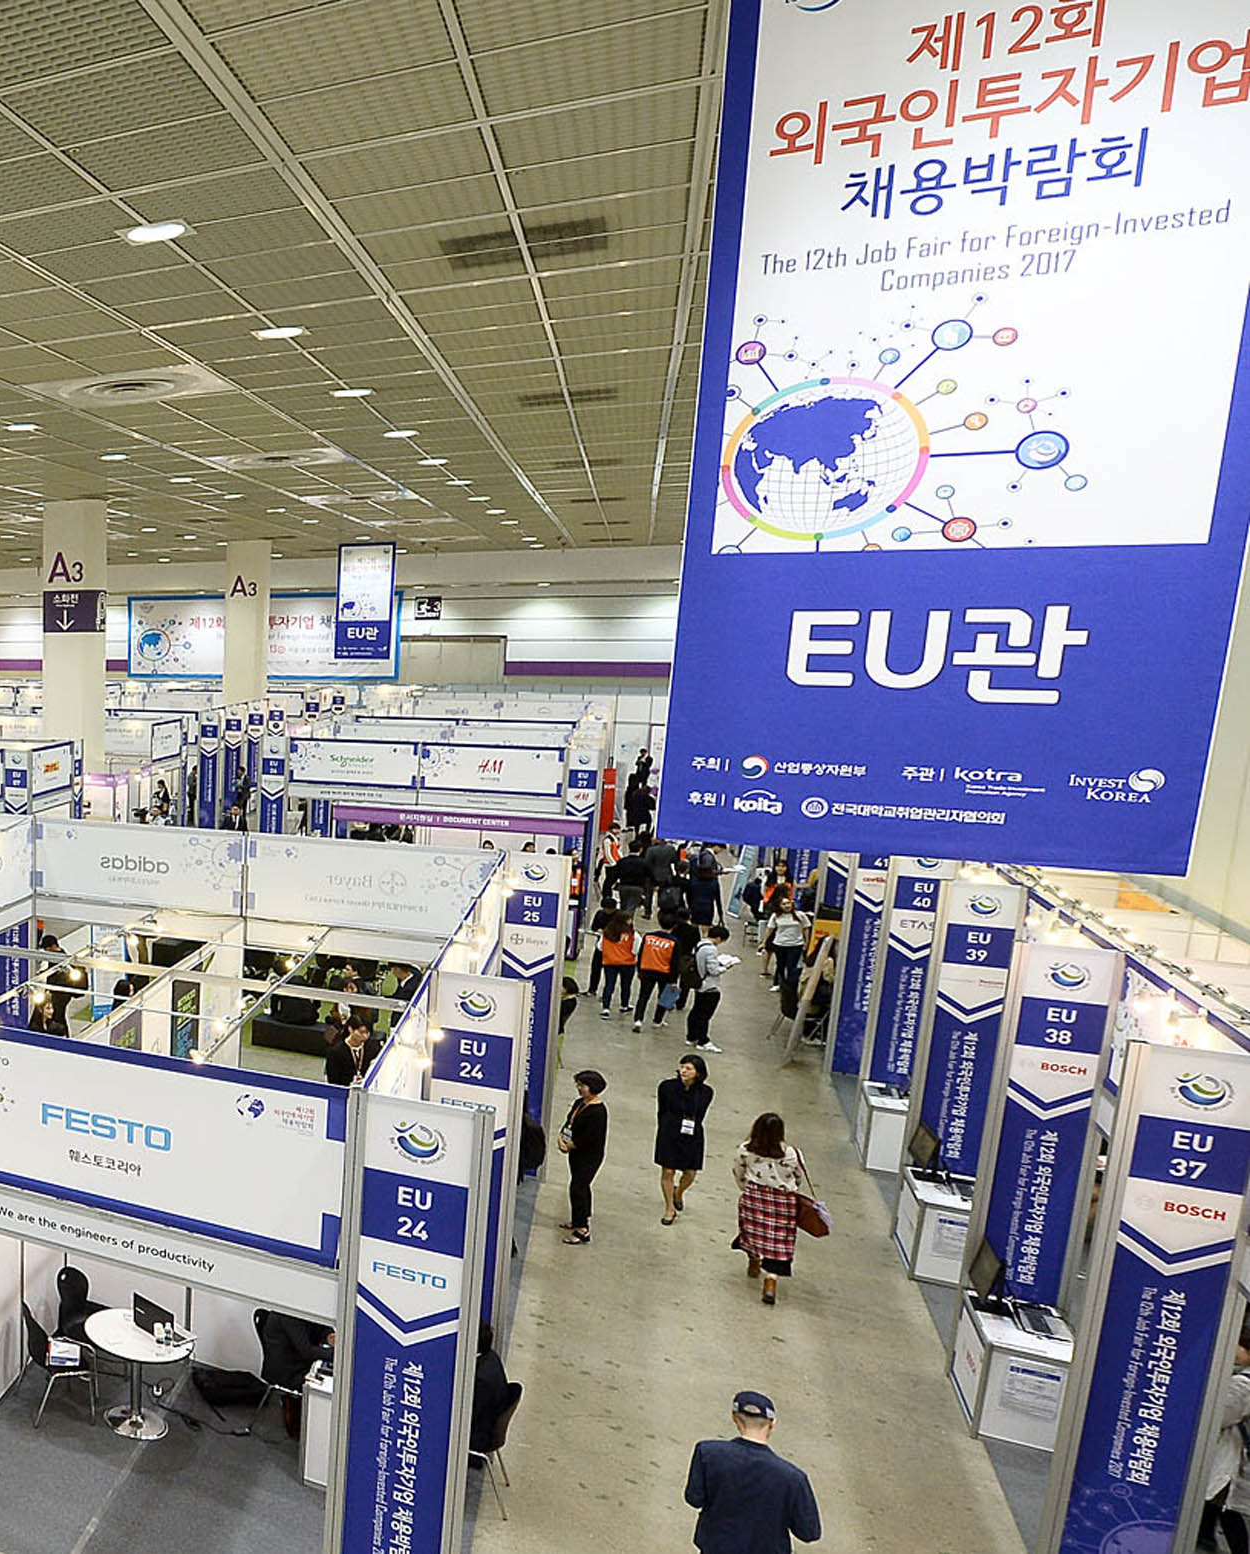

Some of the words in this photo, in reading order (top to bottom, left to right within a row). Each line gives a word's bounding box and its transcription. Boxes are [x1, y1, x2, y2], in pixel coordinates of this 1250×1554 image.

[906, 0, 1106, 71] 제12회
[767, 28, 1250, 166] 외국인투자기업
[840, 126, 1149, 220] 채용박람회
[760, 252, 798, 276] The
[804, 247, 848, 272] 12th
[856, 242, 898, 267] Job
[905, 236, 952, 260] Fair
[960, 230, 997, 254] for
[1005, 199, 1231, 251] Foreign-Invested
[880, 259, 1010, 292] Companies
[1020, 250, 1077, 277] 2017
[48, 551, 84, 583] A3
[230, 575, 257, 598] A3
[347, 626, 380, 641] EU관
[785, 604, 1091, 706] EU관
[773, 761, 867, 778] 산업통상자원부
[901, 766, 935, 782] 주관
[954, 767, 1023, 783] kotra
[1068, 773, 1127, 790] INVEST
[687, 790, 717, 807] 후원
[733, 796, 784, 815] koita
[1085, 787, 1152, 804] KOREA
[914, 882, 935, 894] EU
[523, 895, 542, 908] EU
[912, 897, 932, 908] 40
[522, 910, 541, 923] 25
[966, 931, 992, 945] EU
[965, 948, 988, 962] 39
[1046, 1007, 1078, 1024] EU
[459, 1039, 488, 1057] EU
[1044, 1028, 1073, 1045] 38
[459, 1062, 484, 1080] 24
[1040, 1062, 1088, 1076] BOSCH
[40, 1102, 172, 1152] FESTO
[1036, 1130, 1059, 1164] 제12회
[1172, 1130, 1214, 1153] EU
[1168, 1158, 1207, 1180] 37
[396, 1185, 433, 1212] EU
[1024, 1164, 1053, 1234] 외국인투자기업
[1163, 1201, 1227, 1221] BOSCH
[395, 1217, 430, 1243] 24
[17, 1213, 36, 1224] are
[38, 1216, 58, 1230] the
[60, 1223, 118, 1248] engineers
[121, 1239, 135, 1250] of
[137, 1243, 215, 1273] productivity
[1016, 1235, 1042, 1285] 채용박람회
[372, 1261, 448, 1290] FESTO
[1156, 1289, 1187, 1333] 제12회
[400, 1361, 424, 1409] 제12회
[1138, 1333, 1178, 1422] 외국인투자기업
[392, 1410, 420, 1506] 외국인투자기업
[1126, 1422, 1161, 1486] 채용박람회
